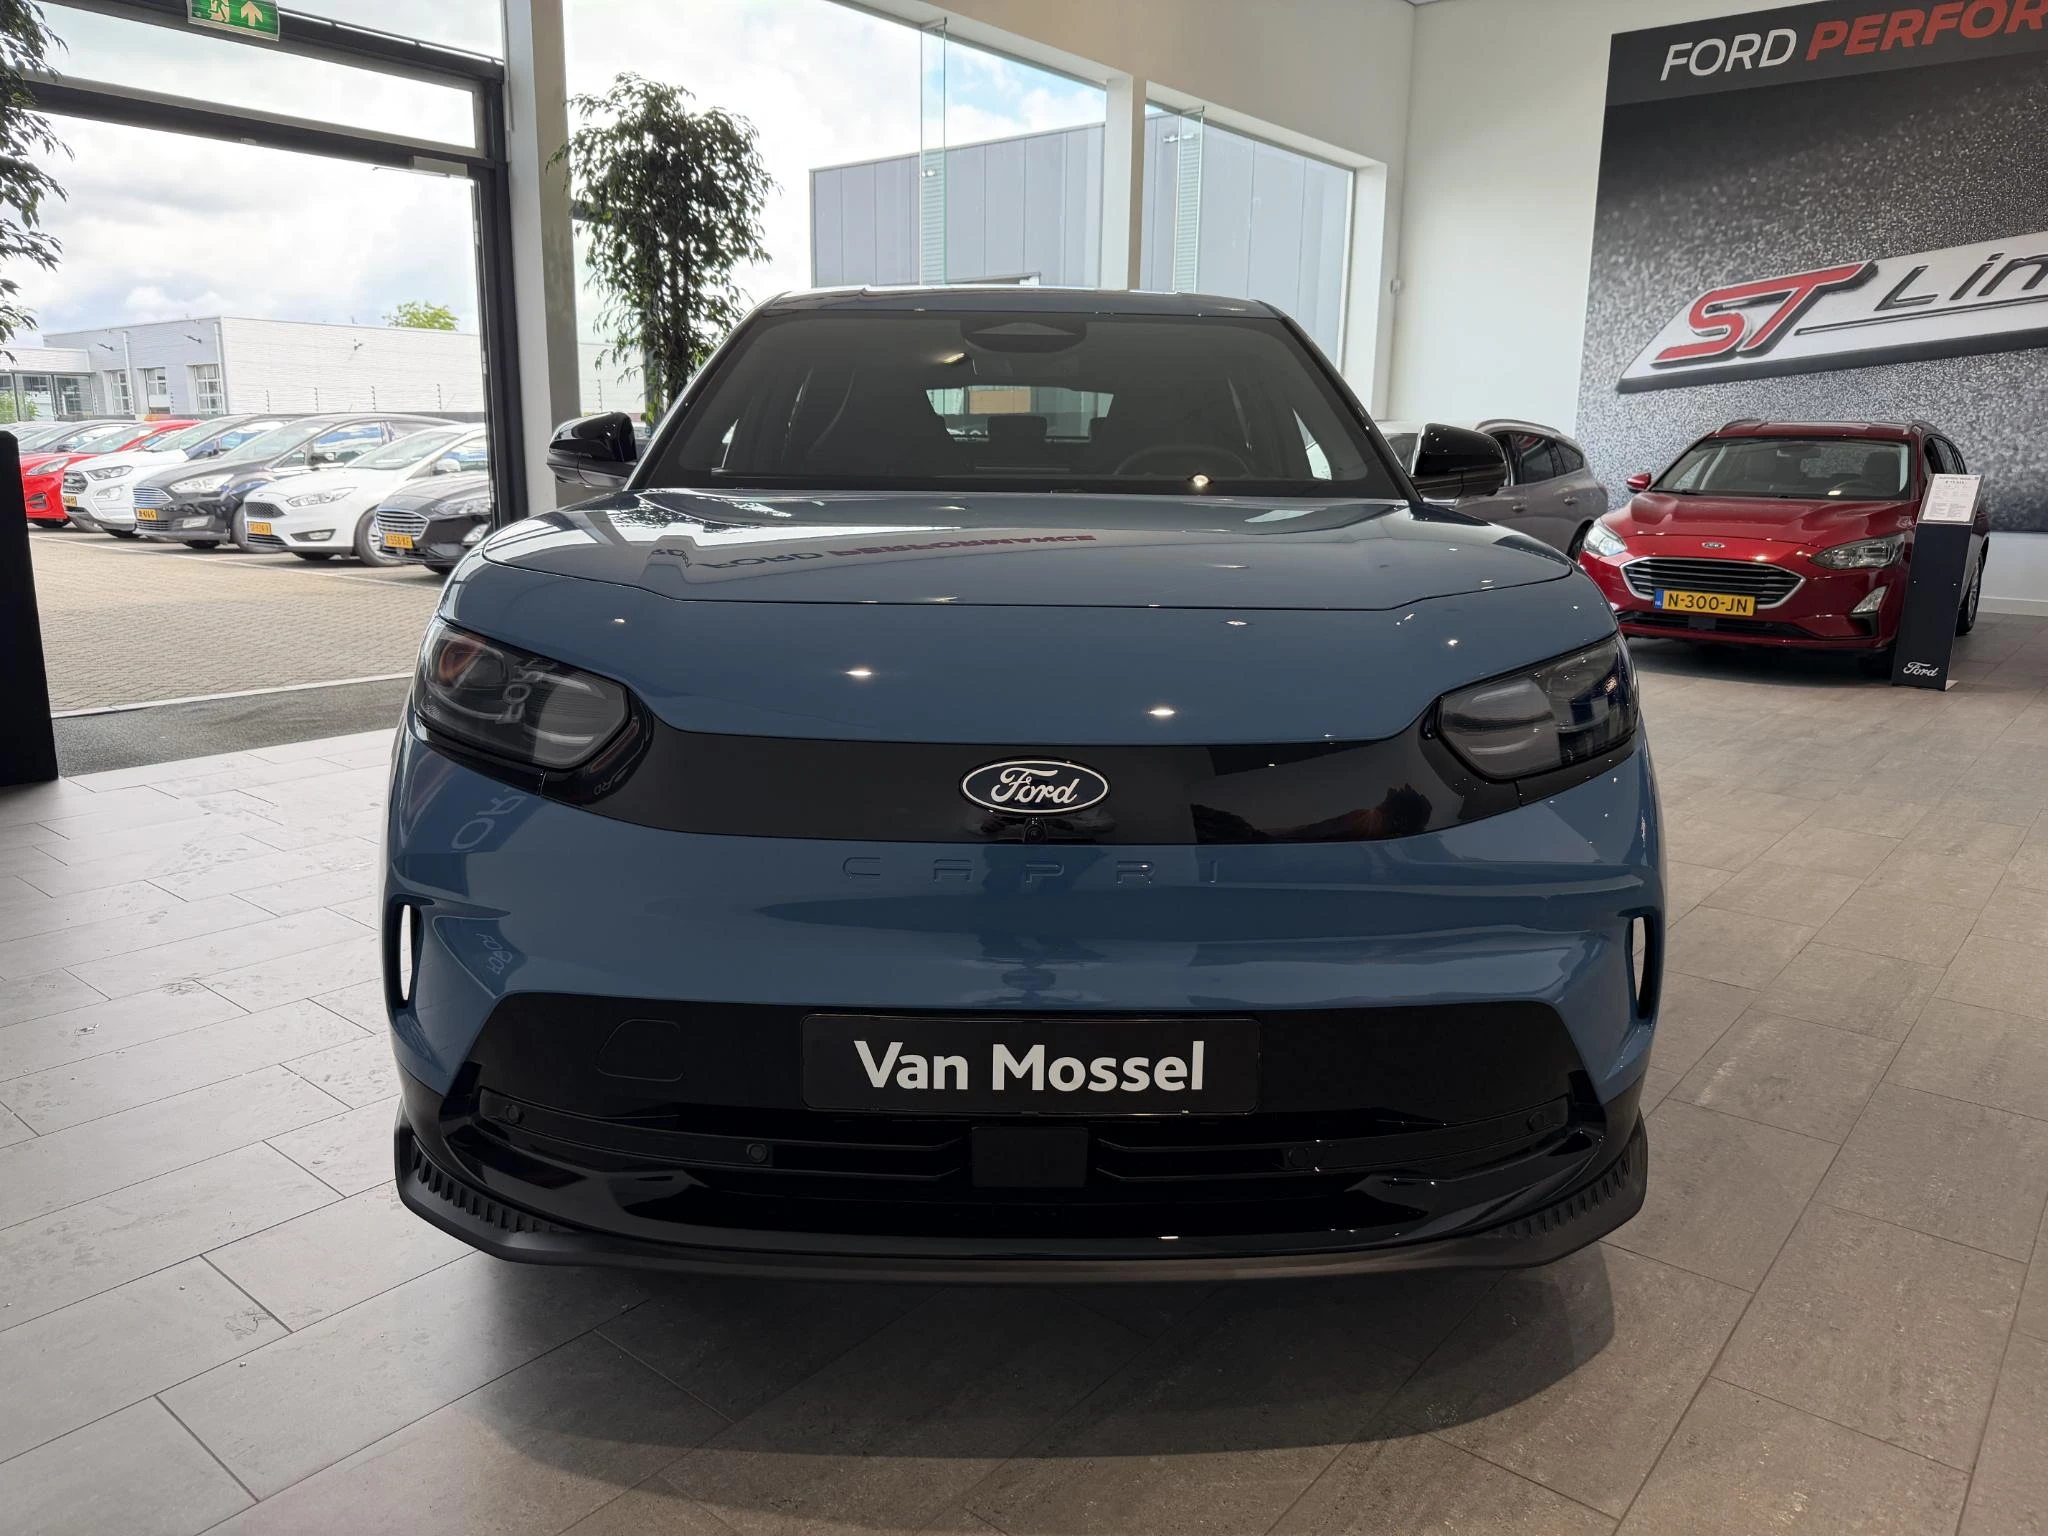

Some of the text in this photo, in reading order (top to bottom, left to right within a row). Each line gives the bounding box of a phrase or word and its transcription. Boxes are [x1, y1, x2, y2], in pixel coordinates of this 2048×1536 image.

[1660, 28, 1797, 81] FORD
[1653, 262, 1877, 367] ST
[1667, 593, 1748, 613] N-300-JN
[1903, 661, 1939, 676] Ford
[989, 767, 1078, 804] Ford
[842, 856, 1220, 886] CAPRI
[854, 1040, 1204, 1092] Van Mossel
